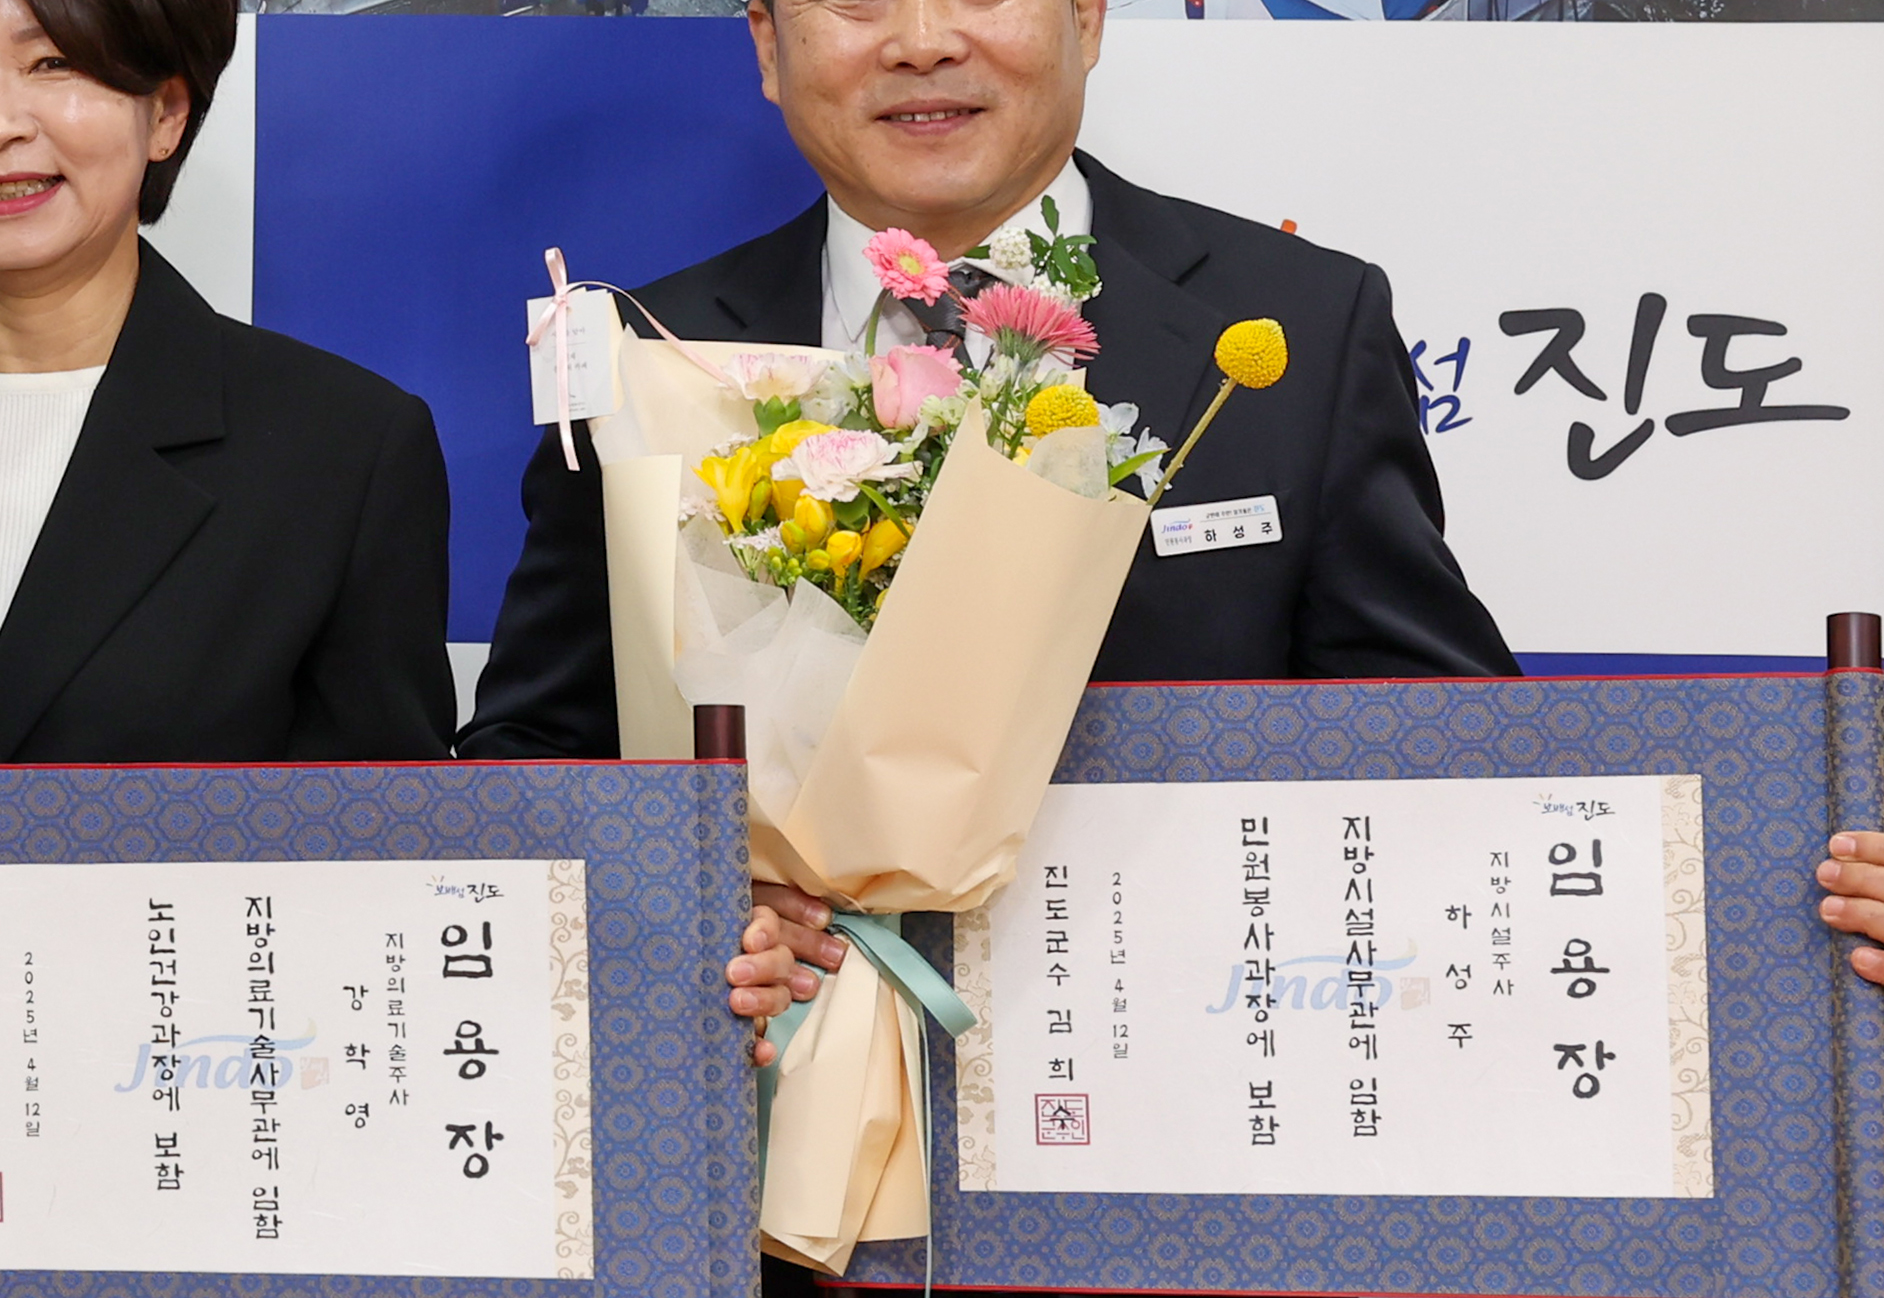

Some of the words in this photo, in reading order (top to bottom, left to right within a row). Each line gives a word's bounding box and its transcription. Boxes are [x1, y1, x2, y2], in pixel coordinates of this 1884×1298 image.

[1498, 291, 1851, 481] 진도
[1575, 799, 1616, 822] 진도
[466, 882, 505, 904] 진도
[1043, 864, 1071, 987] 진도군수
[1110, 871, 1126, 965] 2025년
[1489, 851, 1515, 996] 지방시설주사
[1240, 816, 1278, 1058] 민원봉사과장에
[1341, 815, 1380, 1061] 지방시설사무관에
[23, 951, 38, 1044] 2025년
[147, 897, 183, 1112] 노인건강과장에
[244, 895, 282, 1171] 지방의료기술사무관에
[385, 932, 410, 1106] 지방의료기술주사
[1112, 978, 1127, 1013] 4월
[25, 1057, 39, 1092] 4월
[1112, 1023, 1129, 1059] 12일
[25, 1102, 41, 1138] 12일
[1248, 1079, 1281, 1146] 보함
[1349, 1077, 1383, 1138] 임함
[154, 1131, 185, 1191] 보함
[252, 1185, 284, 1240] 임함
